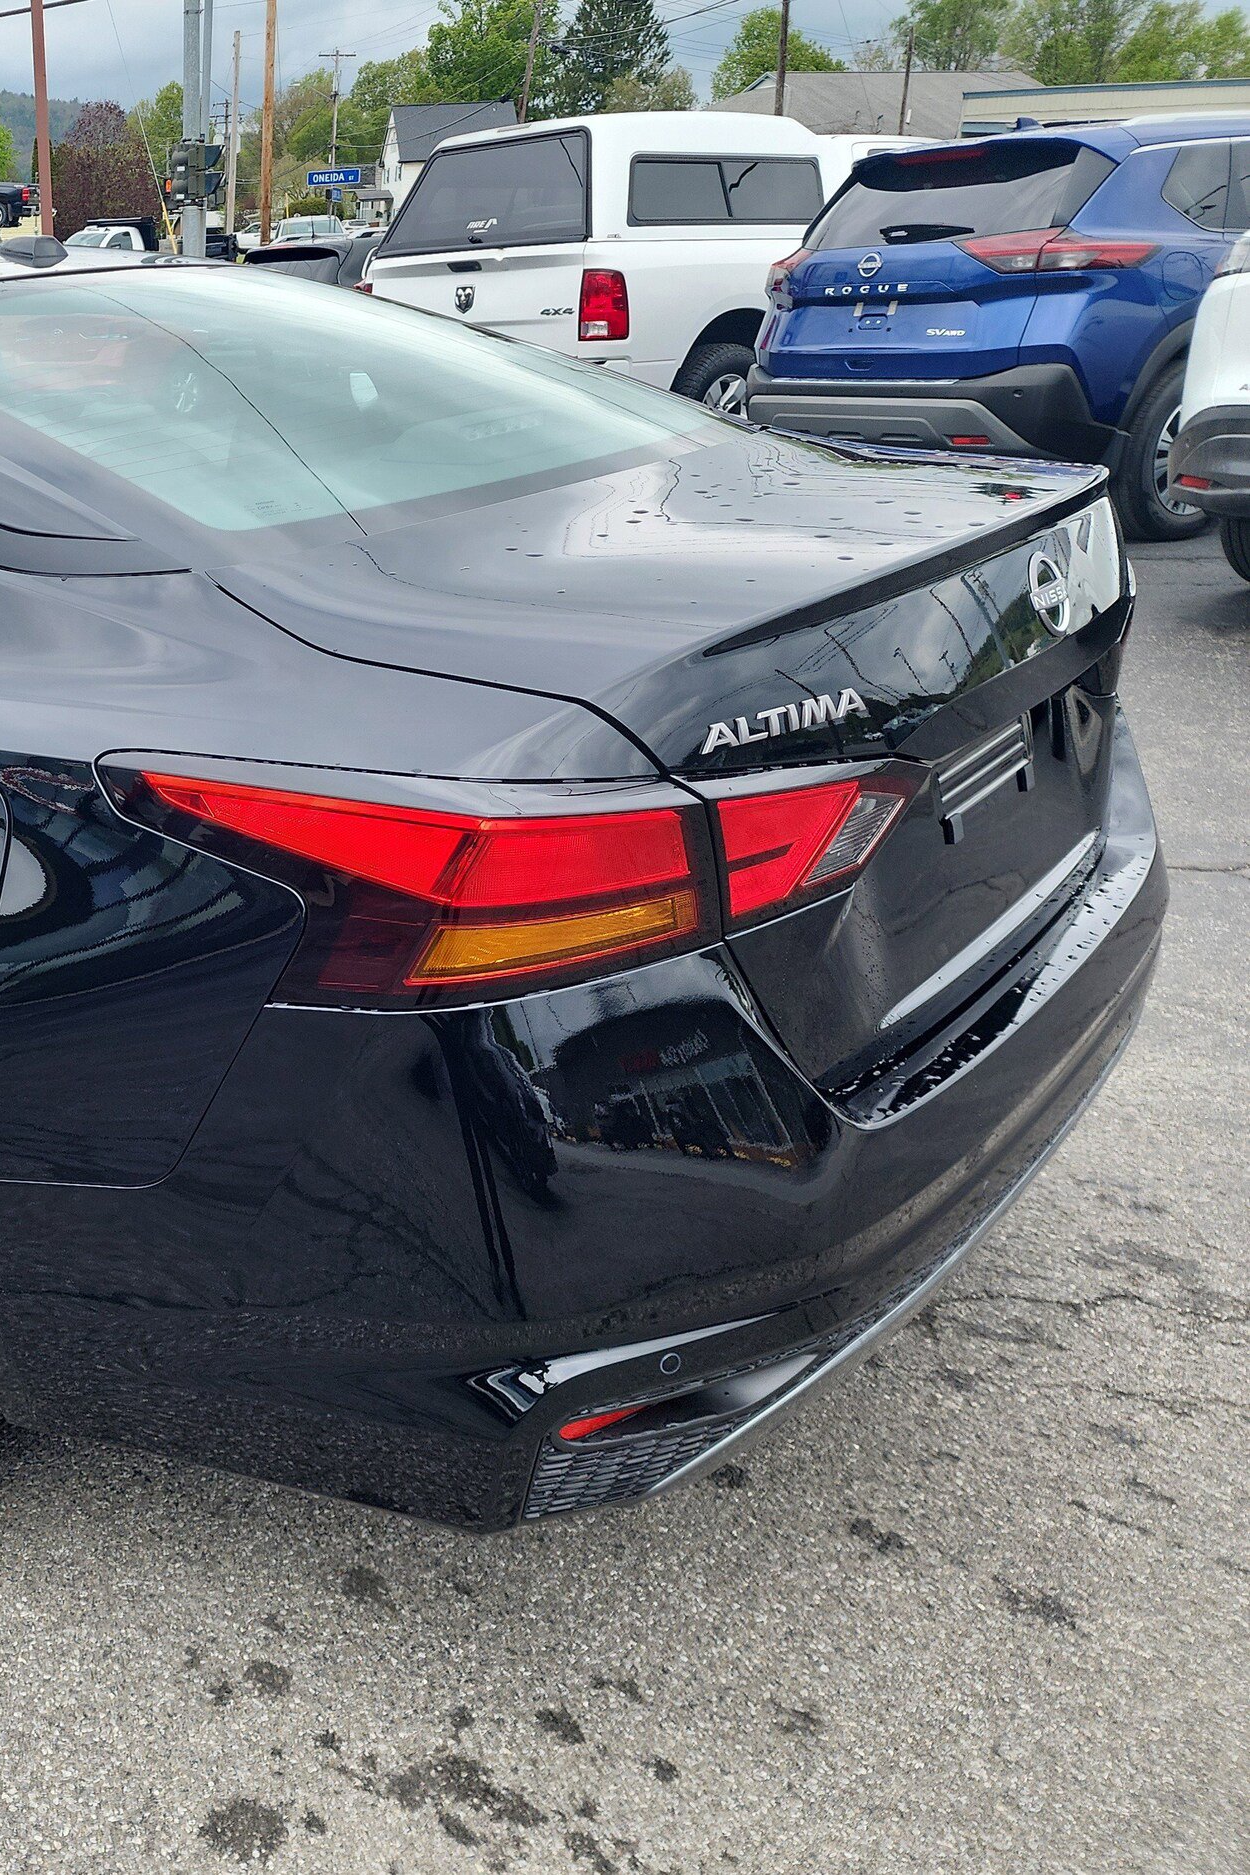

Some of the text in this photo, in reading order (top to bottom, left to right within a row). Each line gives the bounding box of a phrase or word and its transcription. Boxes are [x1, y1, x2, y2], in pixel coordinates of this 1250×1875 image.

[312, 172, 345, 183] ONEIDA
[824, 283, 908, 296] ROGUE
[700, 687, 867, 755] ALTIMA
